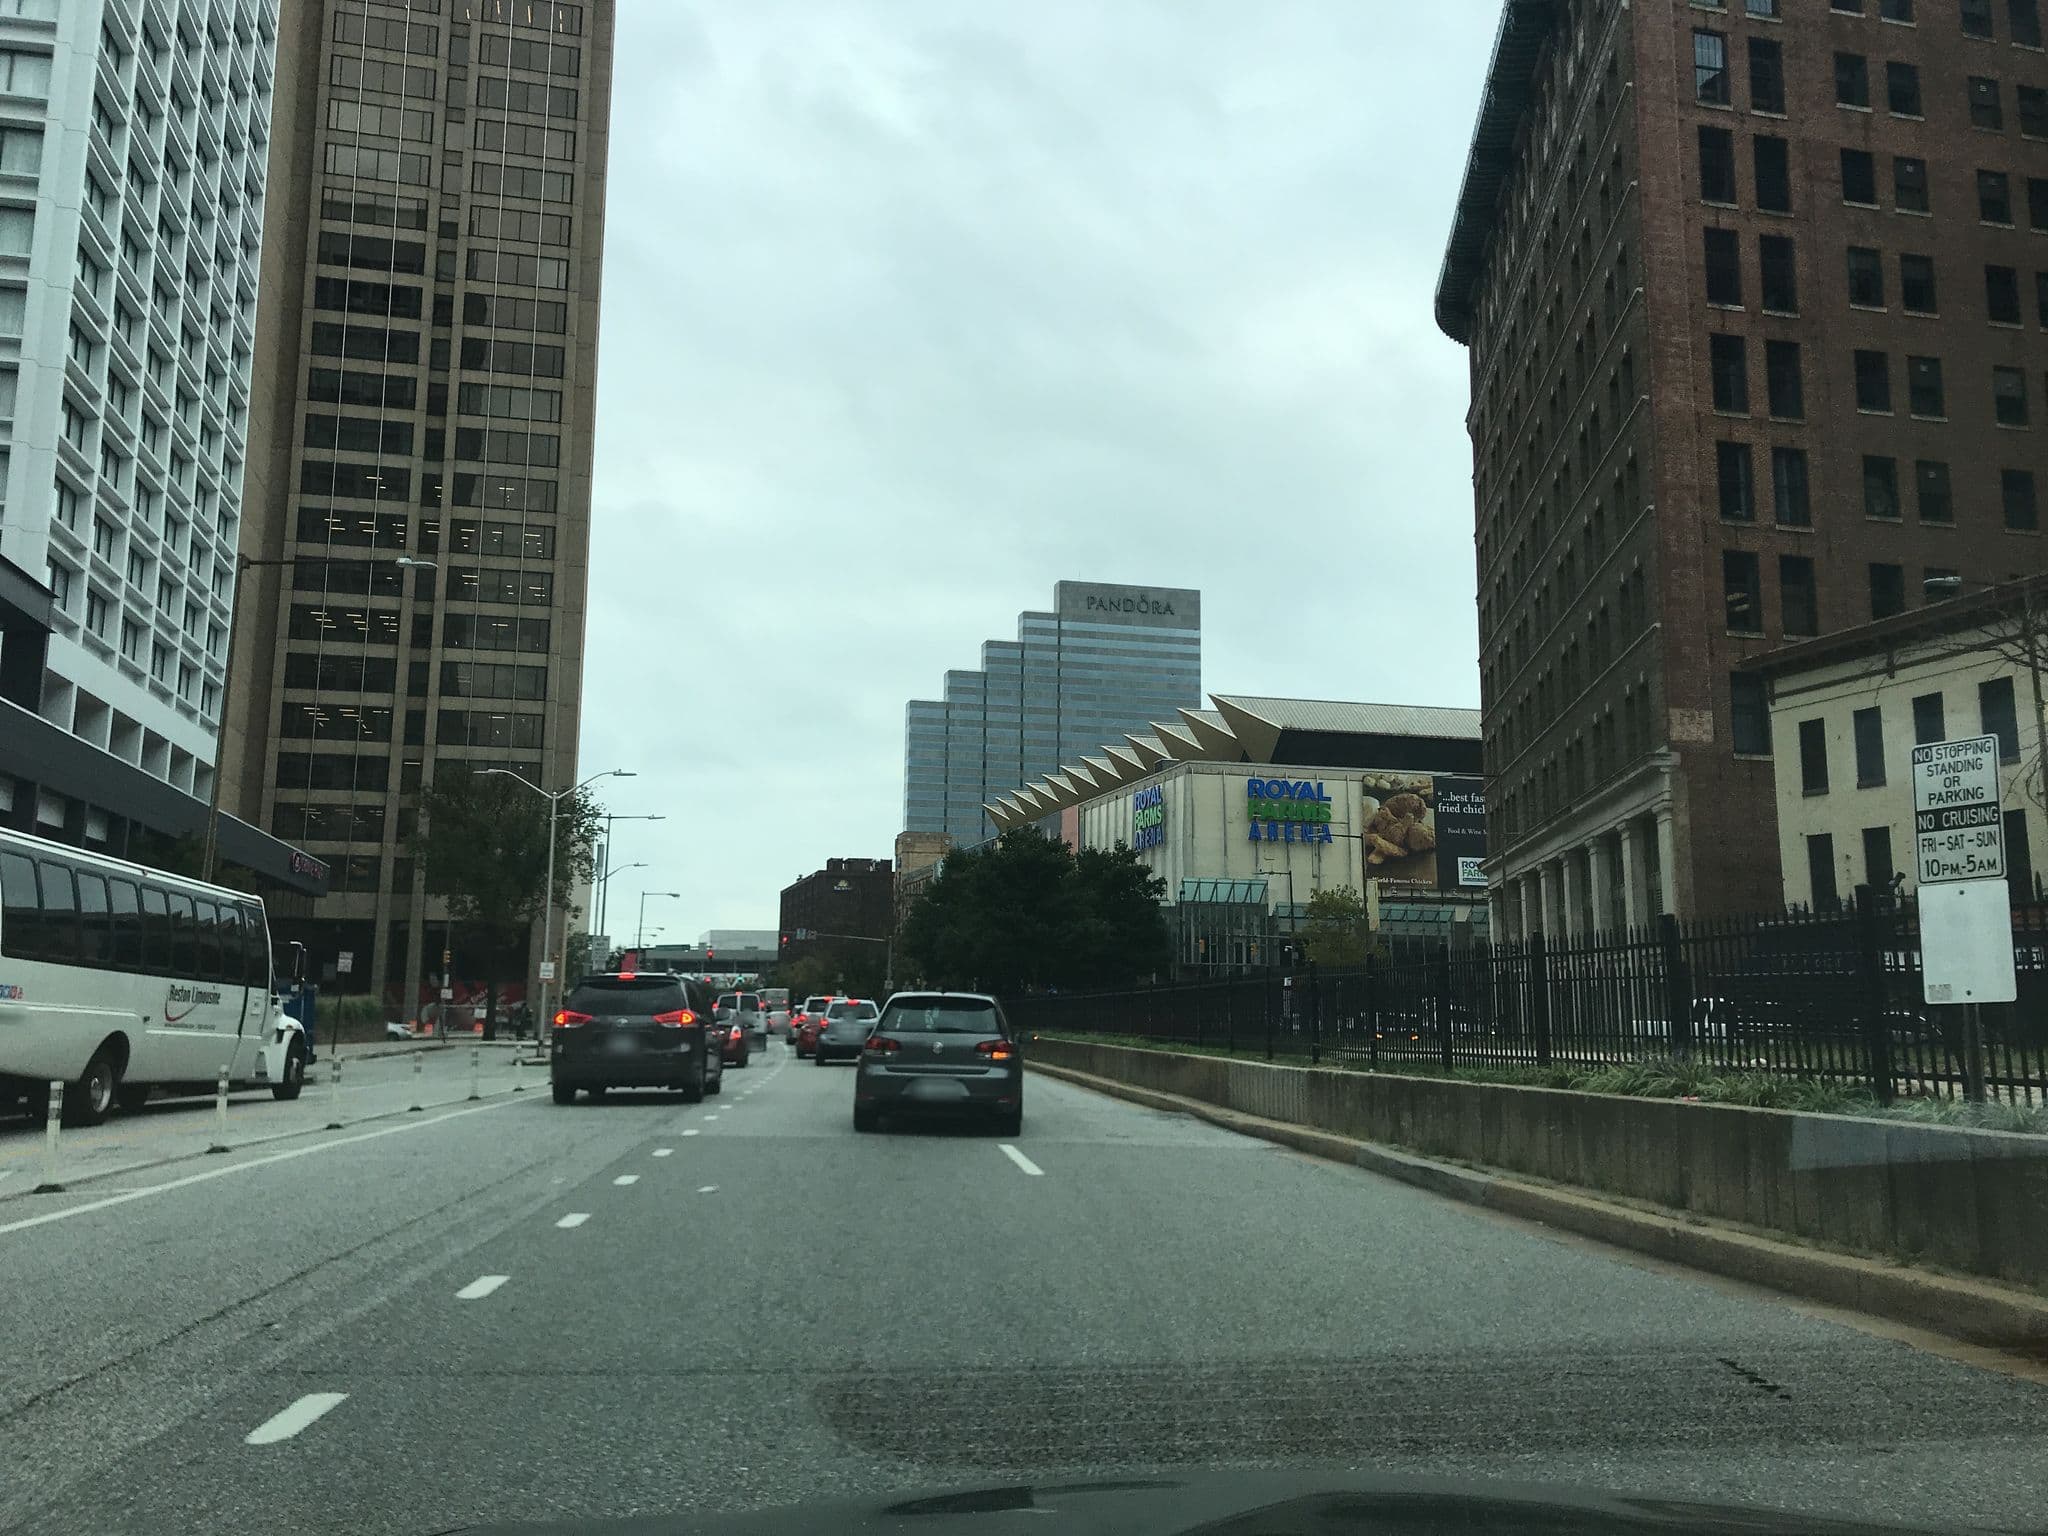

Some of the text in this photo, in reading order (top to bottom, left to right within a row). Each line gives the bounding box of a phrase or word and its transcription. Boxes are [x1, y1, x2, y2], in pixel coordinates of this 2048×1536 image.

[1087, 594, 1175, 615] PANDORA
[1914, 740, 1992, 762] NO STOPPING
[1926, 757, 1983, 777] STANDING
[1247, 778, 1333, 802] ROYAL
[1943, 776, 1961, 788] OR
[1135, 785, 1162, 810] ROYAL
[1438, 802, 1460, 813] fried
[1928, 787, 1984, 806] PARKING
[1135, 804, 1162, 831] FARMS
[1247, 798, 1332, 822] FARMS
[1918, 806, 1999, 830] NO CRUISING
[1135, 825, 1163, 850] ARENA
[1247, 820, 1333, 844] ARENA
[169, 983, 191, 1002] Reston
